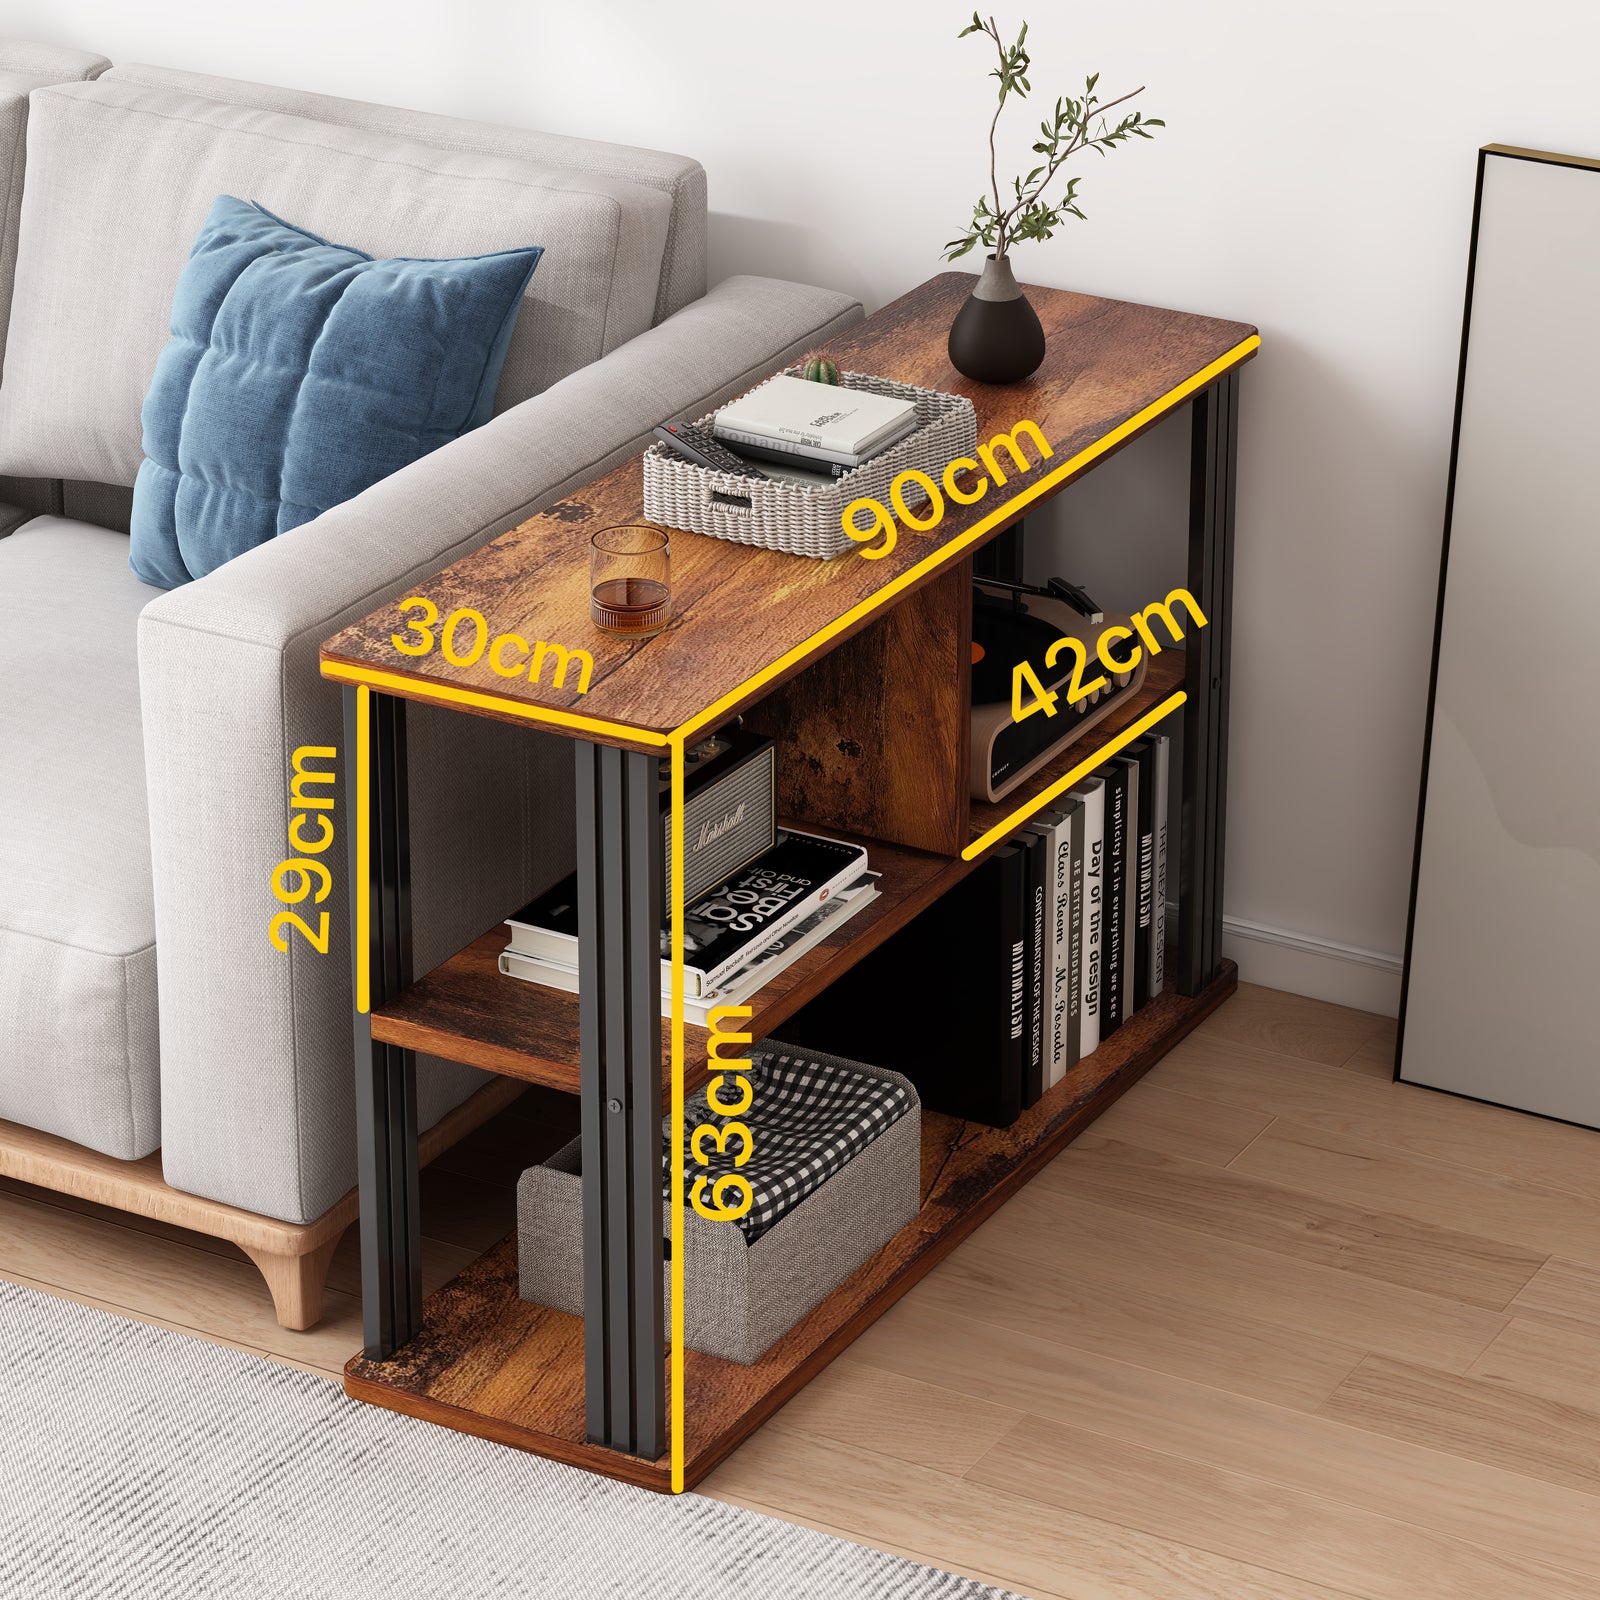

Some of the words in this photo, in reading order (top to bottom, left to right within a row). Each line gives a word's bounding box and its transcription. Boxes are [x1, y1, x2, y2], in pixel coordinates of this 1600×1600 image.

[715, 426, 800, 455] Romanik
[692, 802, 746, 853] Marshall
[1112, 787, 1123, 856] simplicity
[1159, 821, 1167, 857] THE
[776, 874, 812, 886] and
[1057, 841, 1070, 888] Class
[1073, 859, 1081, 876] BE
[1087, 840, 1102, 878] Day
[1139, 832, 1153, 928] MINIMALISM
[738, 875, 805, 901] First
[1072, 880, 1081, 929] BETTER
[1090, 885, 1102, 905] of
[1113, 877, 1121, 892] in
[1157, 863, 1166, 909] NEXT
[1033, 886, 1043, 982] CONTAMINATION
[1056, 892, 1068, 945] Room
[1089, 910, 1101, 945] the
[1109, 896, 1120, 970] everything
[725, 954, 744, 972] Beckett
[1155, 915, 1165, 984] DESIGN
[1011, 940, 1024, 1040] MINIMALISM
[1033, 982, 1041, 999] OF
[1070, 932, 1080, 1017] RENDERINGS
[1085, 949, 1100, 1017] design
[1111, 972, 1118, 992] we
[1032, 999, 1041, 1023] THE
[1053, 1000, 1066, 1064] Posada
[1031, 1022, 1040, 1067] DESIGN
